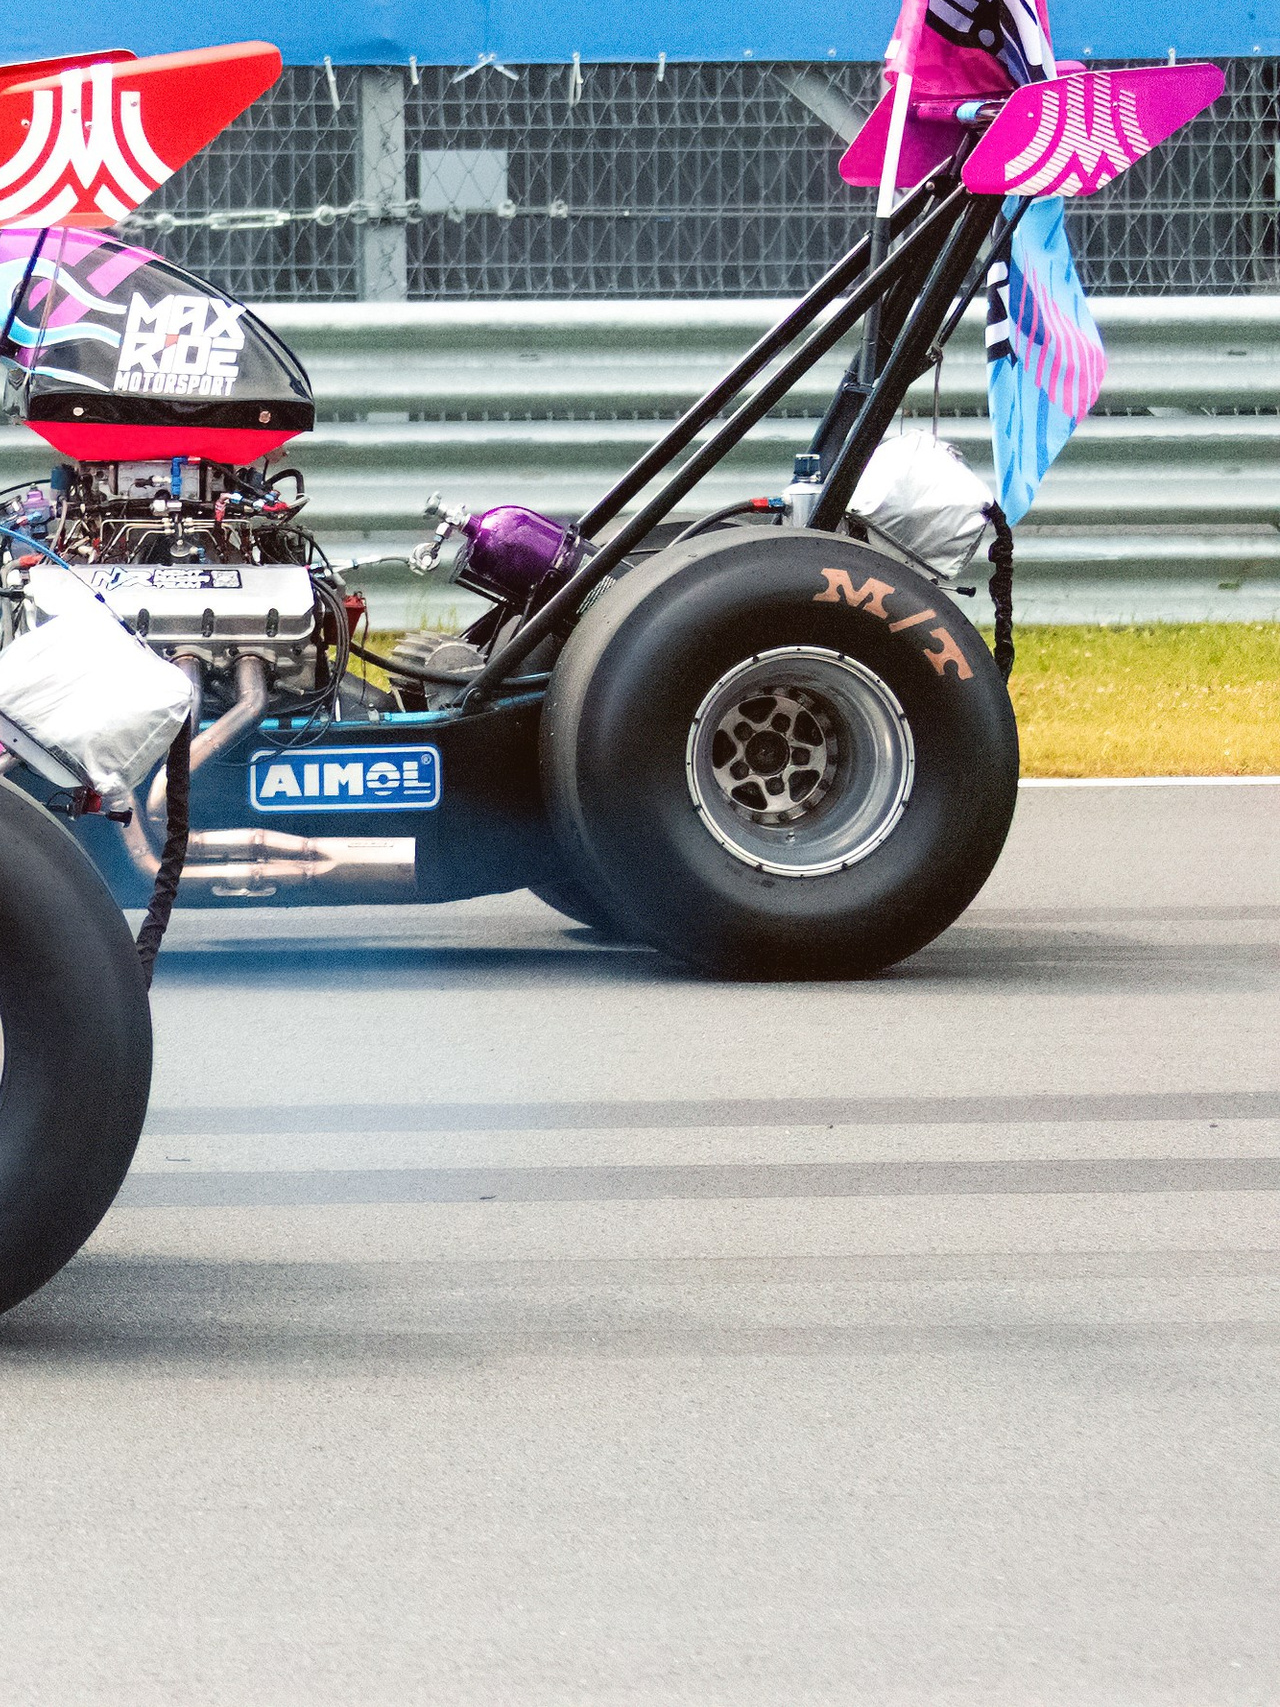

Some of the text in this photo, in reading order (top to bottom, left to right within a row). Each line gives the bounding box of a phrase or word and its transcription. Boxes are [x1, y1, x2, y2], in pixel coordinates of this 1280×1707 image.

[125, 291, 247, 339] MAX
[113, 371, 237, 396] MOTORSPORT
[813, 568, 975, 681] M/T
[259, 761, 432, 798] AIMOL
